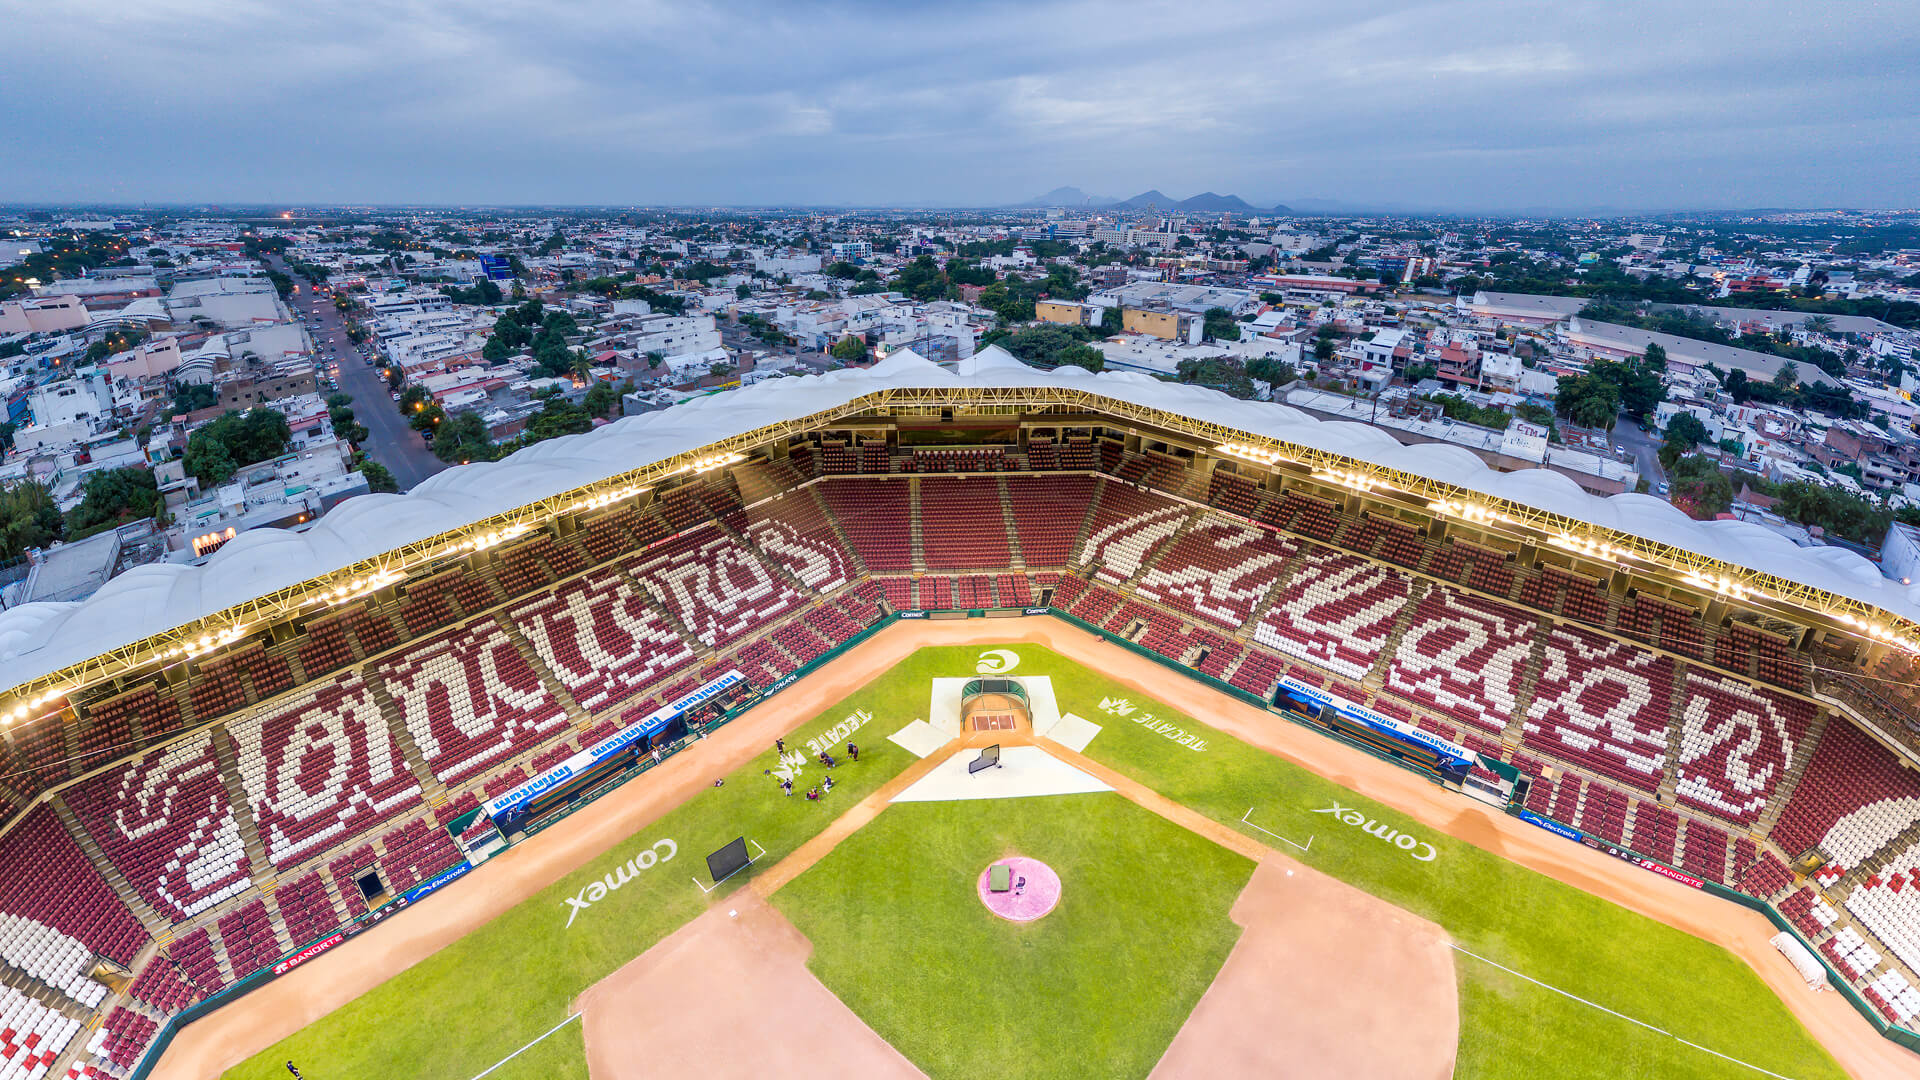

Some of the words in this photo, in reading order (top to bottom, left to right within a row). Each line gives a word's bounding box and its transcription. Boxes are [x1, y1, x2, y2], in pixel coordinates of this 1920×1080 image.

[673, 675, 739, 711] infinitum
[1284, 679, 1333, 703] infinitum
[590, 716, 663, 757] infinitum
[806, 707, 872, 756] TECATE
[1131, 711, 1208, 752] TECATE
[1346, 704, 1398, 729] infinitum
[494, 765, 573, 810] infinitum
[1310, 800, 1437, 861] Comex
[564, 838, 678, 929] Comex
[1654, 866, 1704, 888] BANORTE
[289, 934, 343, 967] BANORTE
